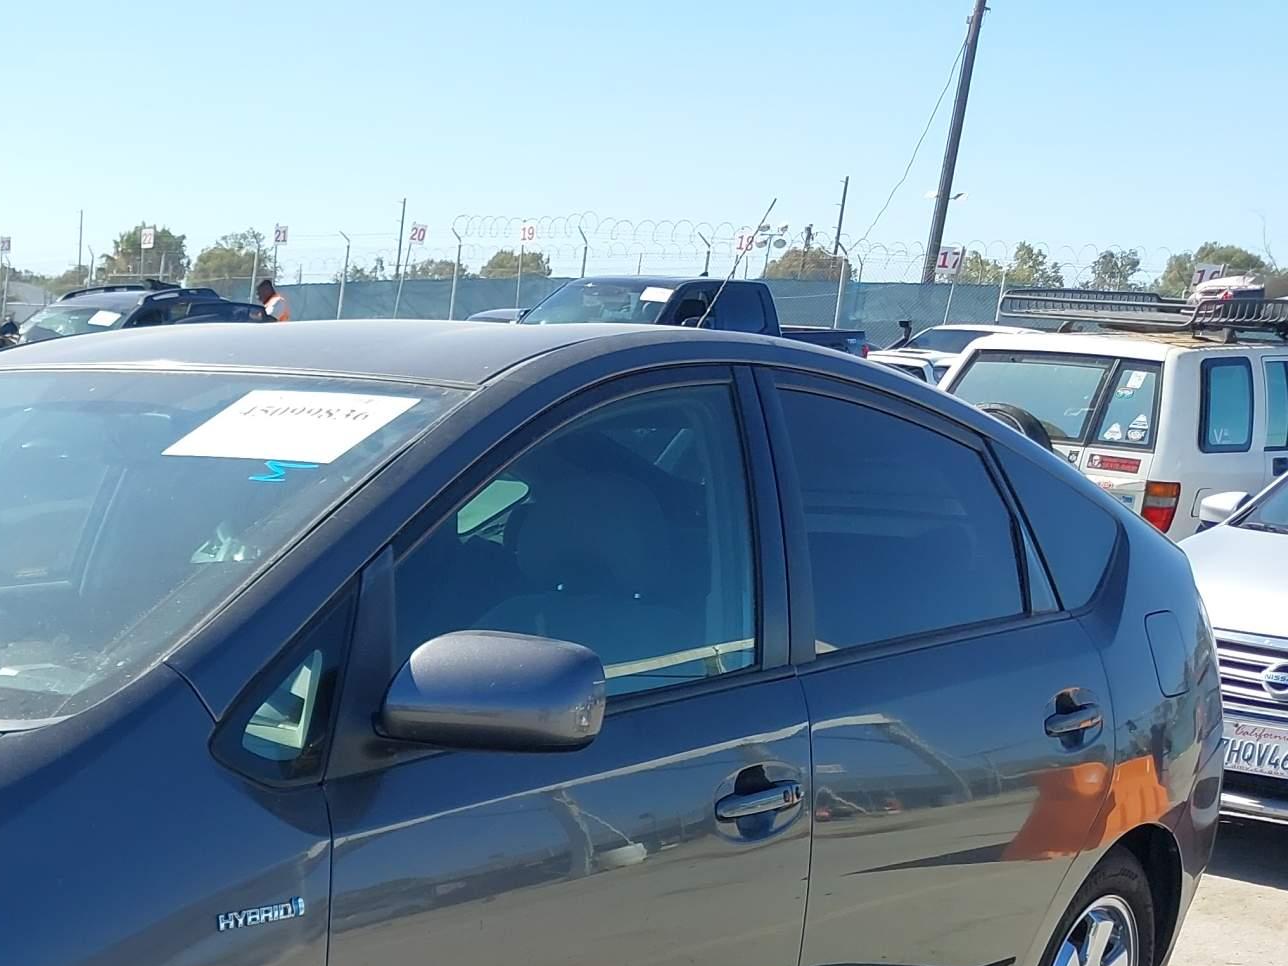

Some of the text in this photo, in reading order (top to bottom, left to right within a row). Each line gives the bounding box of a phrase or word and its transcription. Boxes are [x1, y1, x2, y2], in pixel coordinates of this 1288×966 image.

[274, 229, 287, 242] 21
[410, 227, 426, 241] 20
[521, 226, 535, 241] 19
[736, 234, 754, 251] 18
[937, 251, 960, 269] 17
[218, 902, 295, 931] HYBRID
